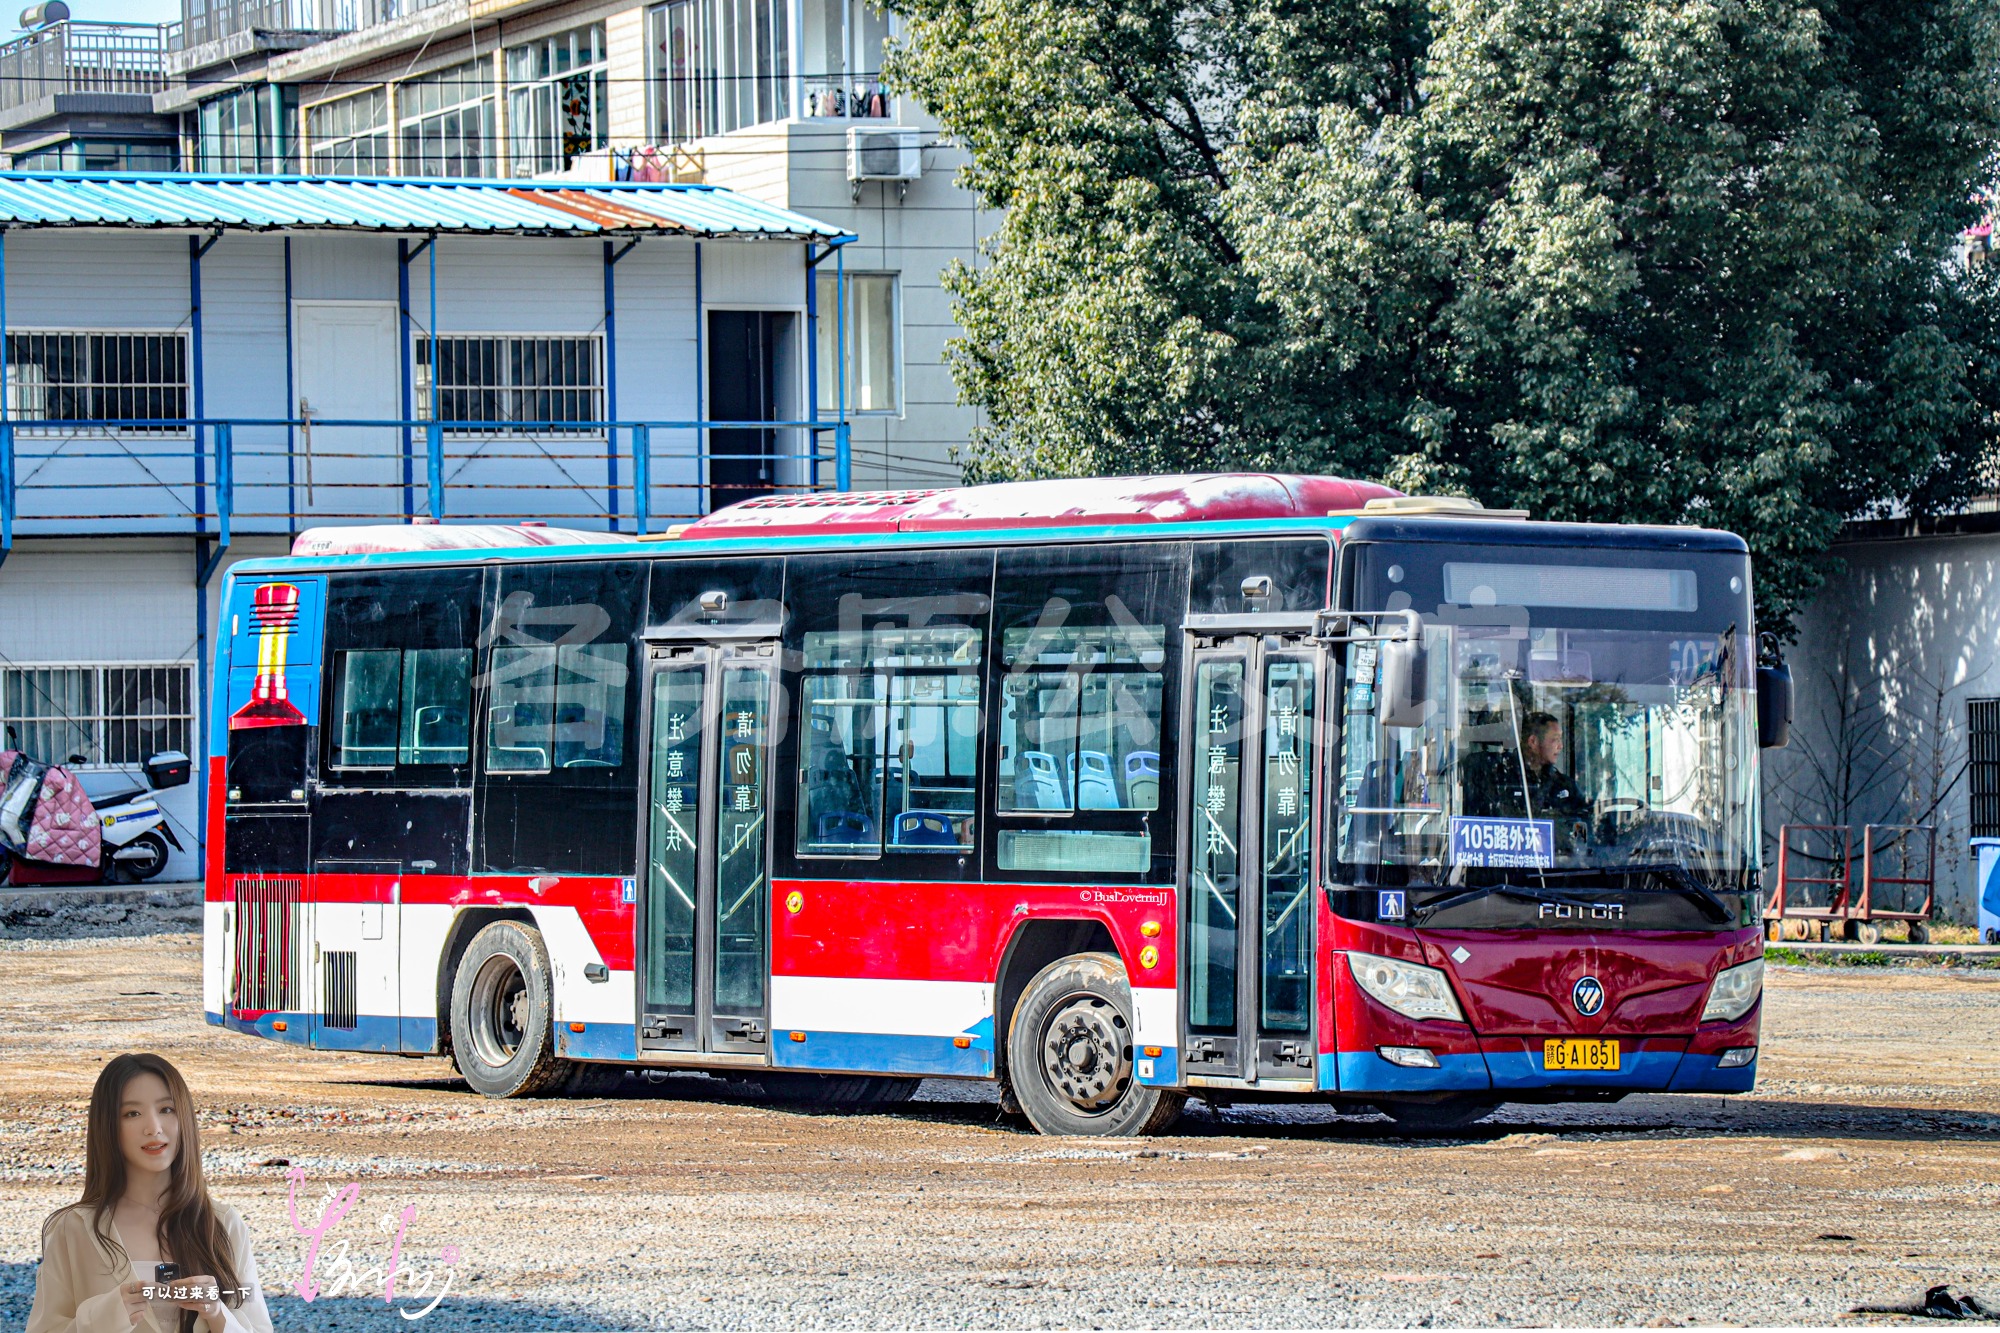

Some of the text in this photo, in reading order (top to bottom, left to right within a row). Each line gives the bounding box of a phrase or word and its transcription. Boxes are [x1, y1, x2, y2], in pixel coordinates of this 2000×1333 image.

[1461, 823, 1541, 852] 105路外环
[1539, 903, 1623, 920] FOTON
